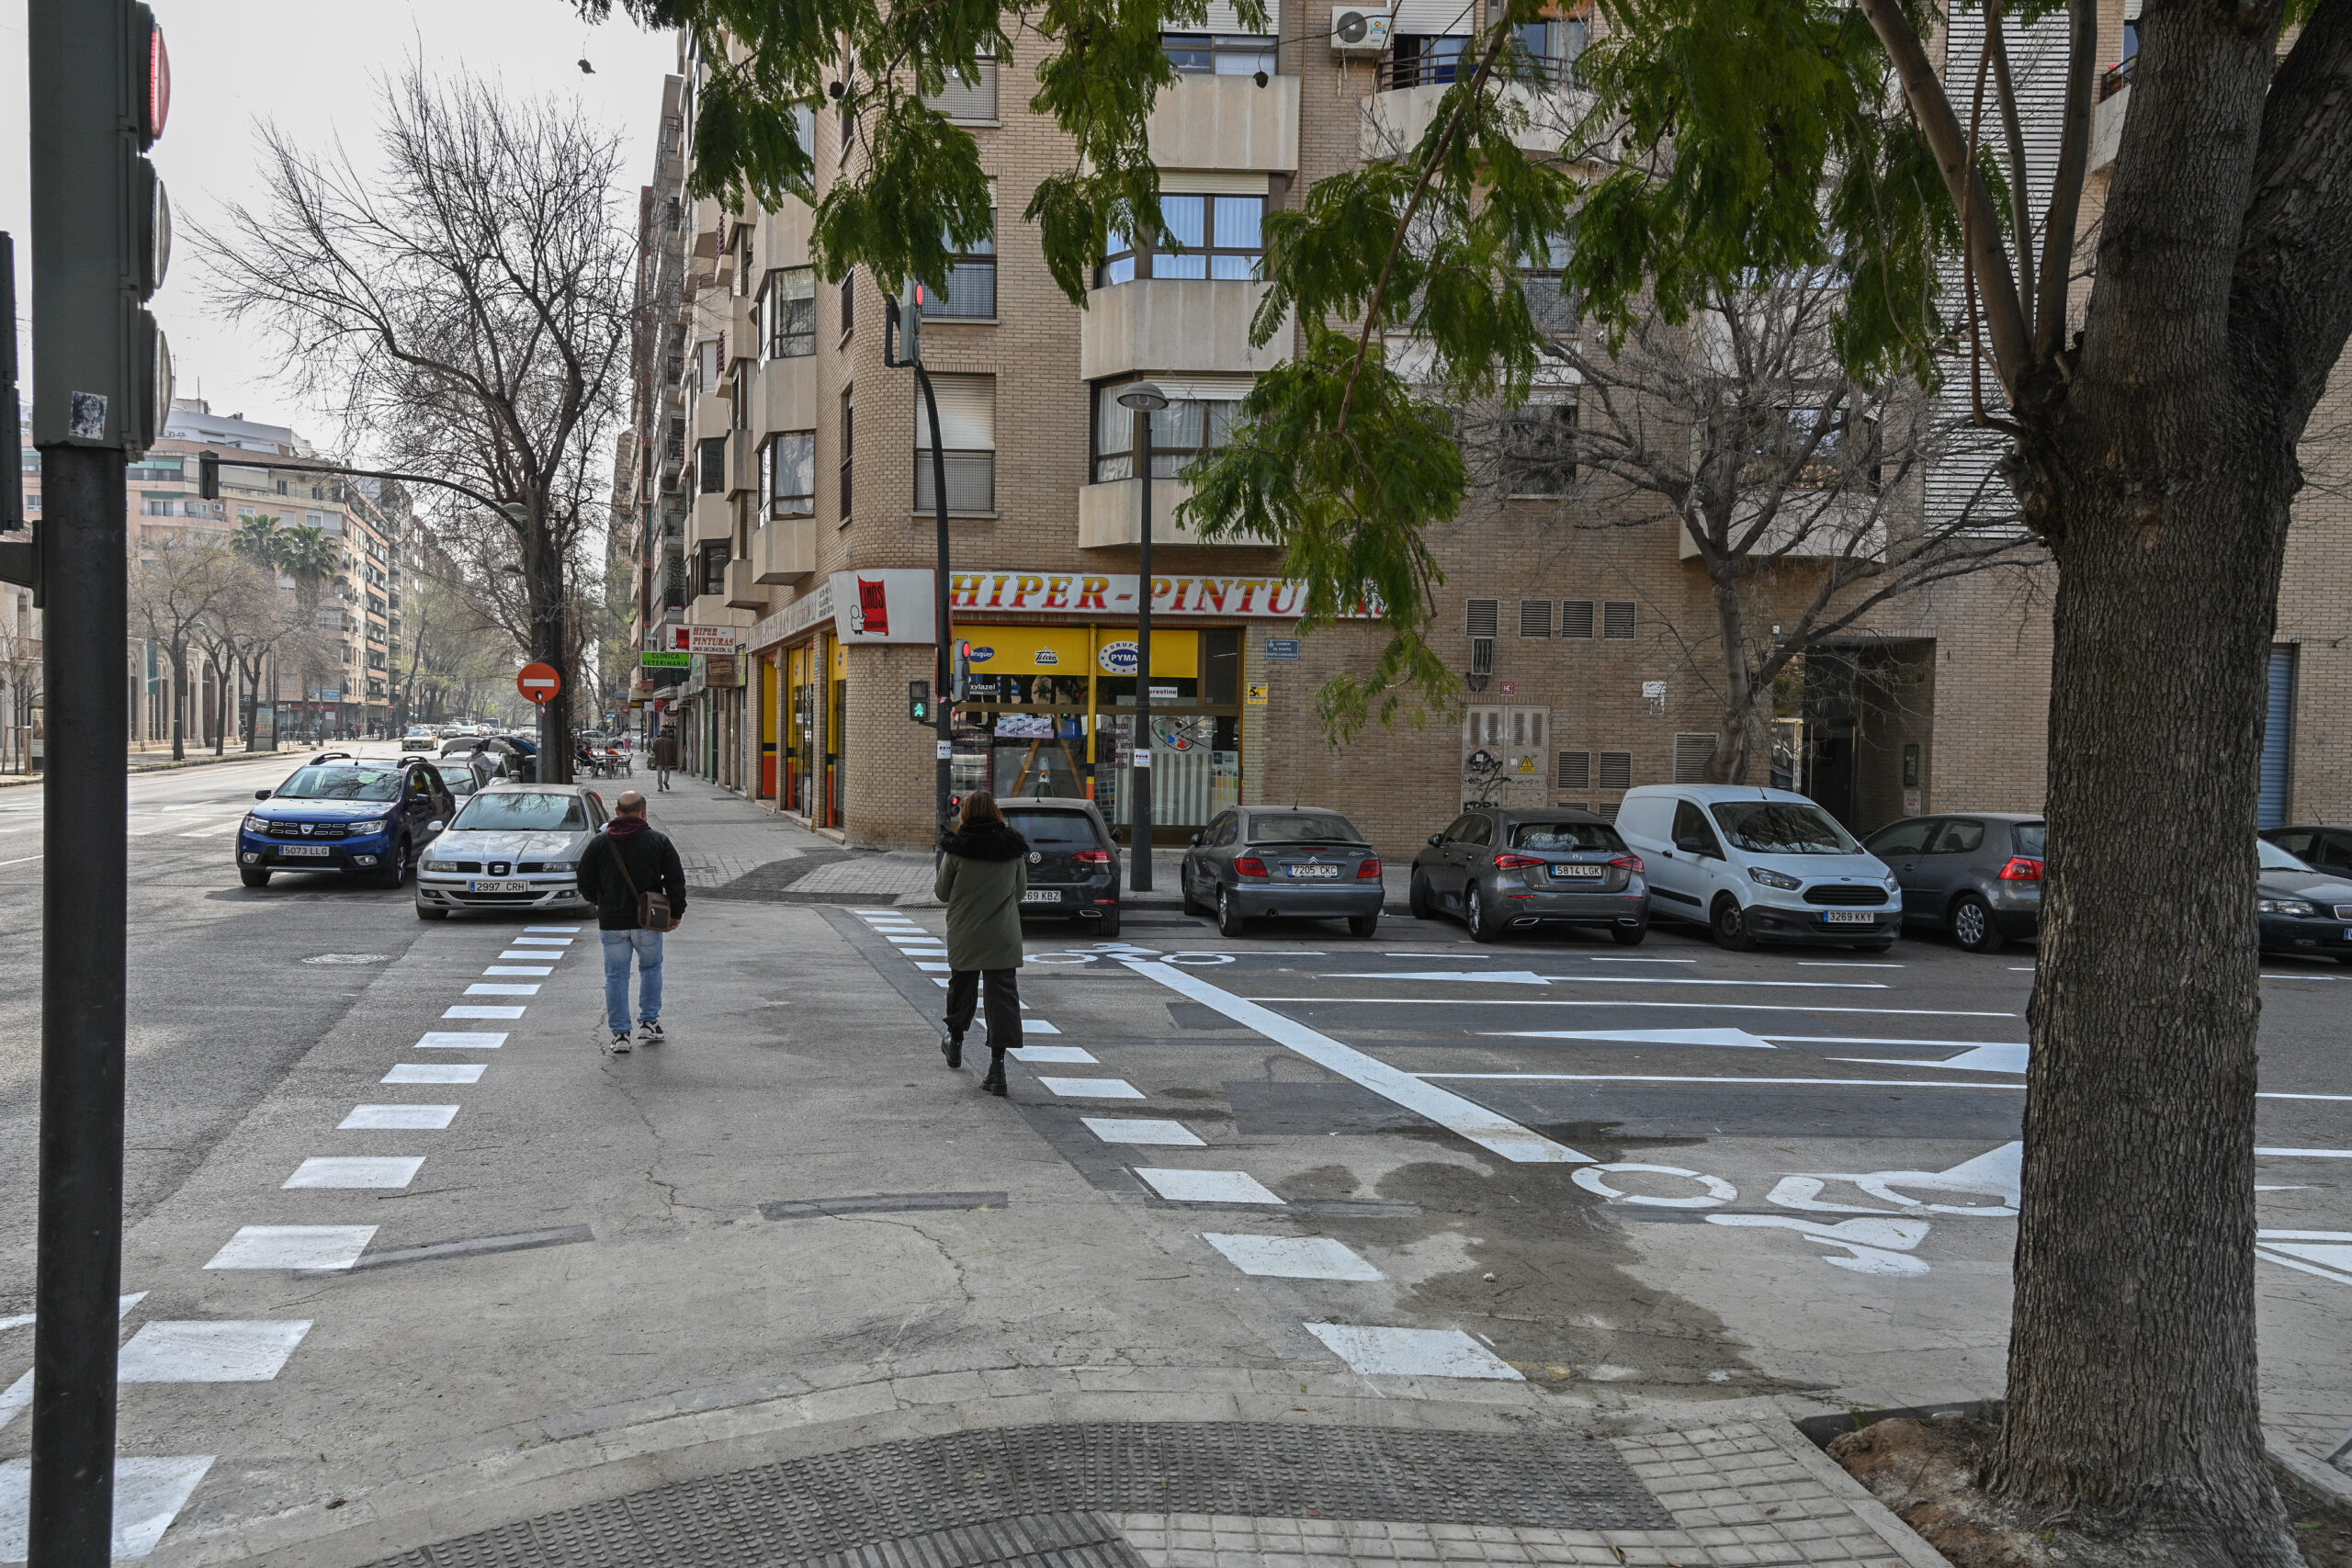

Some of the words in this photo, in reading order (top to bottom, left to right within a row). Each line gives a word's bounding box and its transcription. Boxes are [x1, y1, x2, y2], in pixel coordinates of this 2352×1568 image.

[860, 585, 885, 609] LINOS
[693, 626, 718, 636] HIPER
[693, 637, 734, 646] PINTURAS
[1110, 642, 1138, 650] GRUPO
[970, 649, 993, 659] Bruguer
[1111, 653, 1138, 662] PYMA
[284, 846, 308, 855] 5073
[310, 847, 328, 856] LLG
[1294, 865, 1316, 874] 7205
[1320, 865, 1337, 874] CKC
[1557, 865, 1580, 874] 5814
[1582, 865, 1600, 875] LGK
[476, 882, 501, 892] 2997
[506, 882, 525, 892] CRH
[1041, 891, 1059, 900] KBZ
[1829, 912, 1853, 921] 3269
[1855, 912, 1871, 921] KKY
